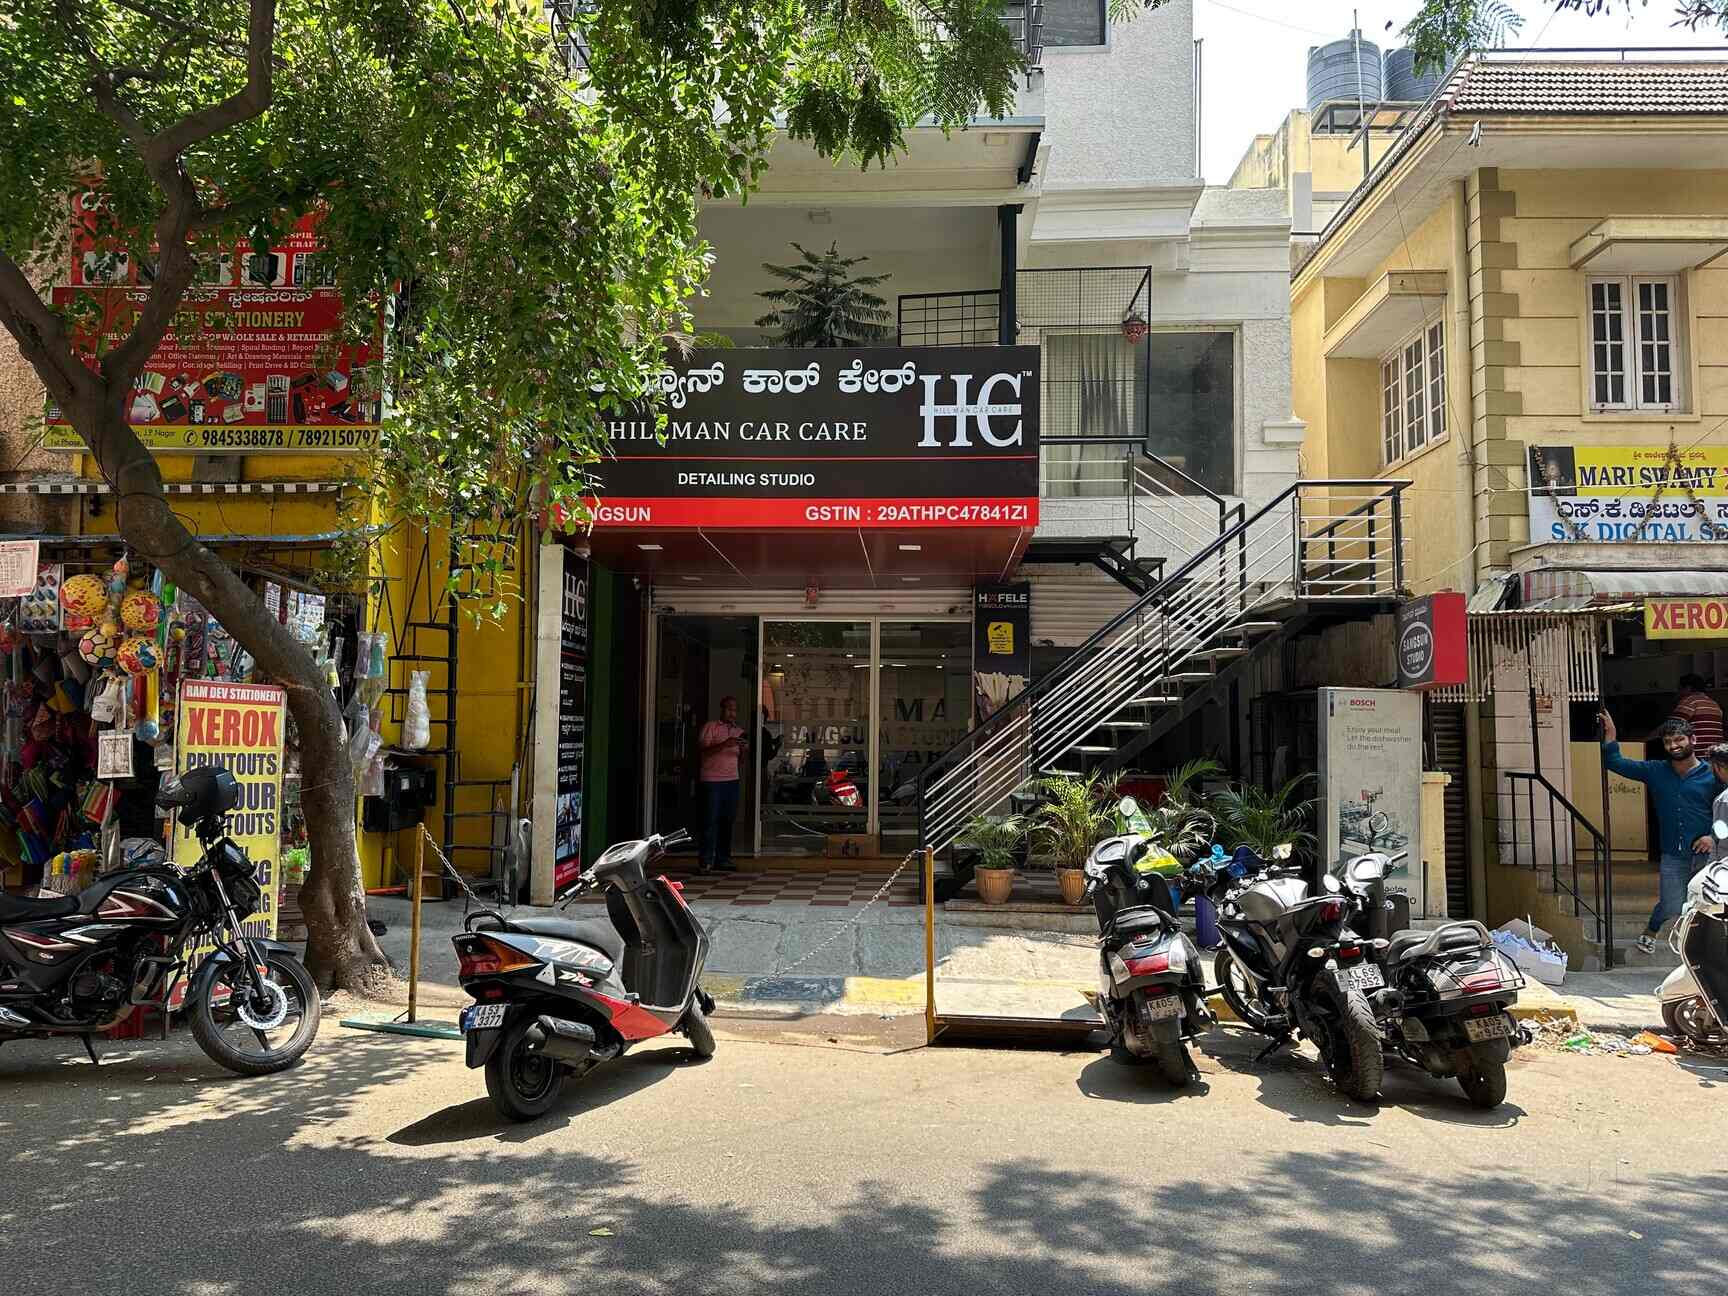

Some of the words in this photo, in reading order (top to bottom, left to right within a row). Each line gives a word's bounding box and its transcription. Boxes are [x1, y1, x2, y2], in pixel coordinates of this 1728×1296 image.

[202, 429, 283, 447] 9845338878
[297, 429, 380, 446] 7892150797
[609, 421, 731, 440] HILMAN
[739, 422, 791, 441] CAR
[799, 422, 867, 441] CARE
[678, 473, 755, 486] DETAILING
[760, 473, 815, 486] STUDIO
[805, 506, 861, 521] GSTIN
[1651, 602, 1728, 629] XERO
[186, 685, 208, 699] RAM
[210, 687, 228, 699] DEV
[230, 688, 282, 702] STATIONERY
[1350, 698, 1376, 706] BOSCH
[186, 707, 278, 747] XEROX
